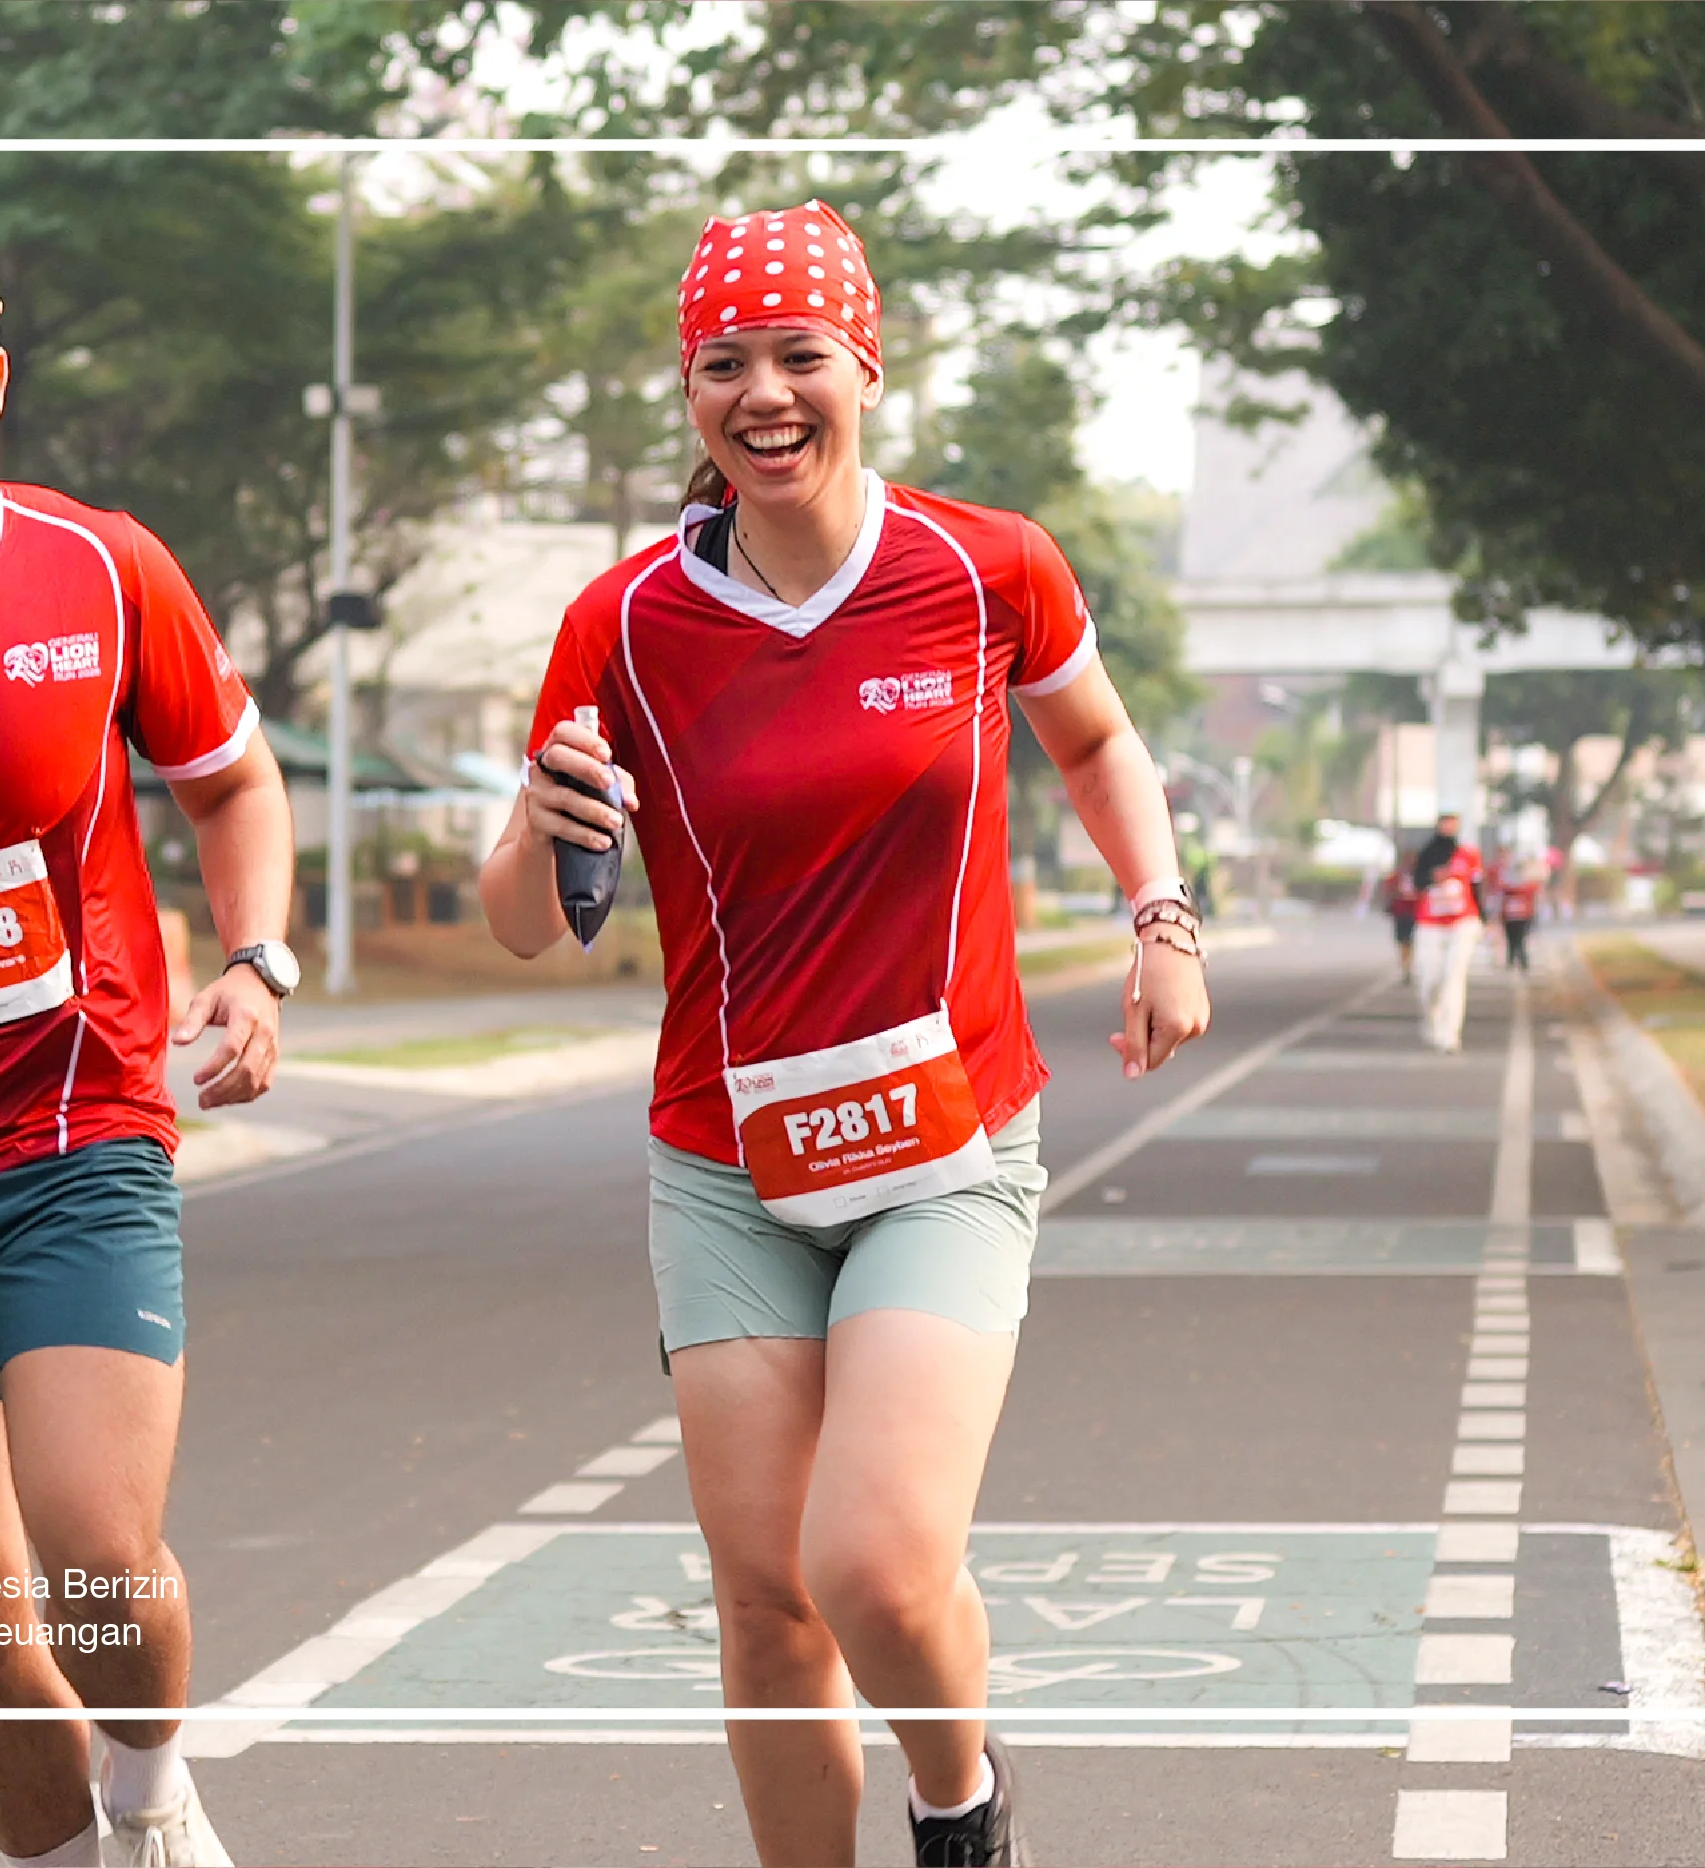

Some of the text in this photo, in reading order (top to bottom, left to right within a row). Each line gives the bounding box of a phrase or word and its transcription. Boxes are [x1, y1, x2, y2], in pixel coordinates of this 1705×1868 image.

[50, 641, 99, 662] LION
[52, 657, 99, 674] HEART
[783, 1083, 917, 1156] F2817
